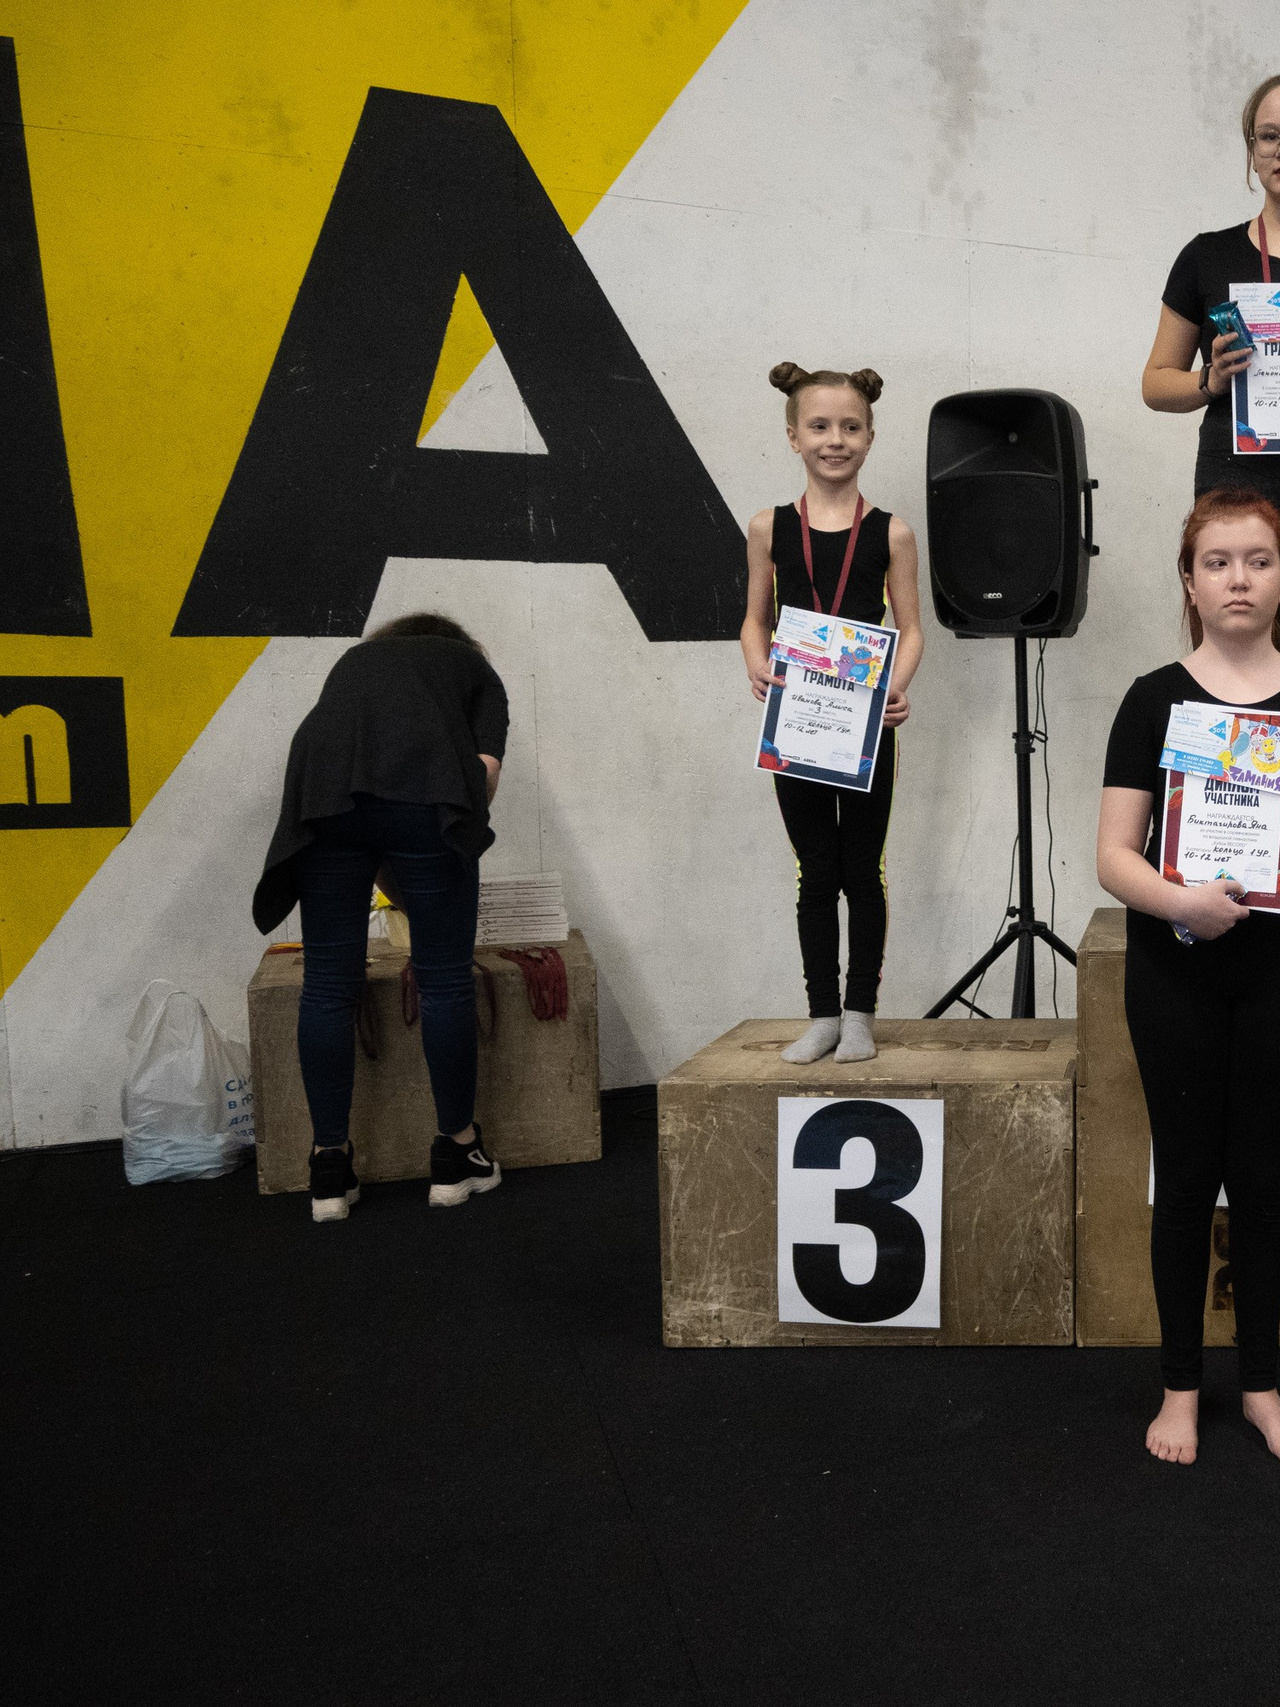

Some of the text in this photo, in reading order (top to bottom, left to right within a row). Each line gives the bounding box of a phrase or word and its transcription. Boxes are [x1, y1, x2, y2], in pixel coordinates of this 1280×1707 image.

[792, 694, 853, 712] Иванова Алиса
[1204, 792, 1259, 807] УЧАСТНИКА
[1207, 813, 1254, 821] НАГРАЖДАЕТСЯ
[1248, 820, 1268, 830] Яна
[792, 1100, 926, 1323] 3
